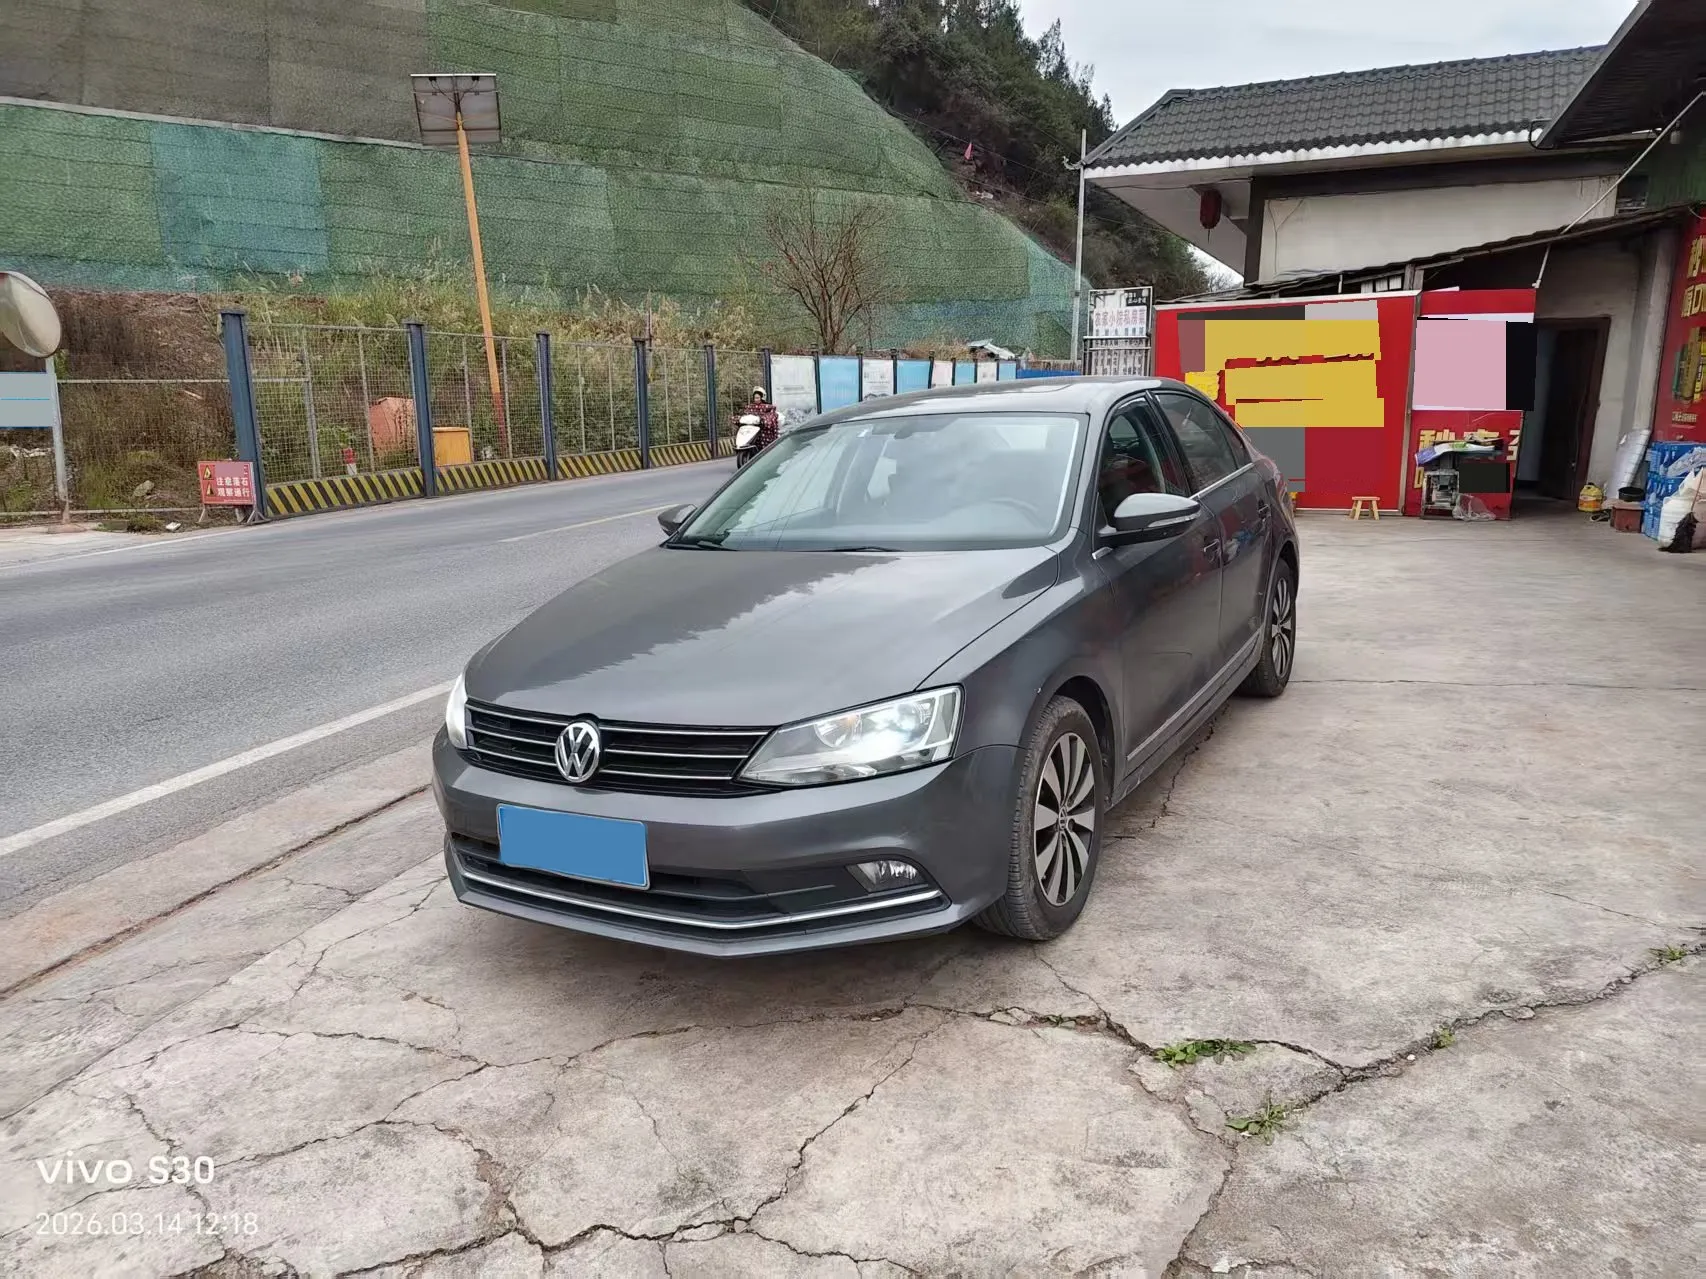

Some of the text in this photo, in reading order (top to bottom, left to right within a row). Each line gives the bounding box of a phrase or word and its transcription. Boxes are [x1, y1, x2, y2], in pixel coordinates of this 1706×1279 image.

[216, 476, 249, 486] 注意落石
[217, 487, 250, 497] 观察通行
